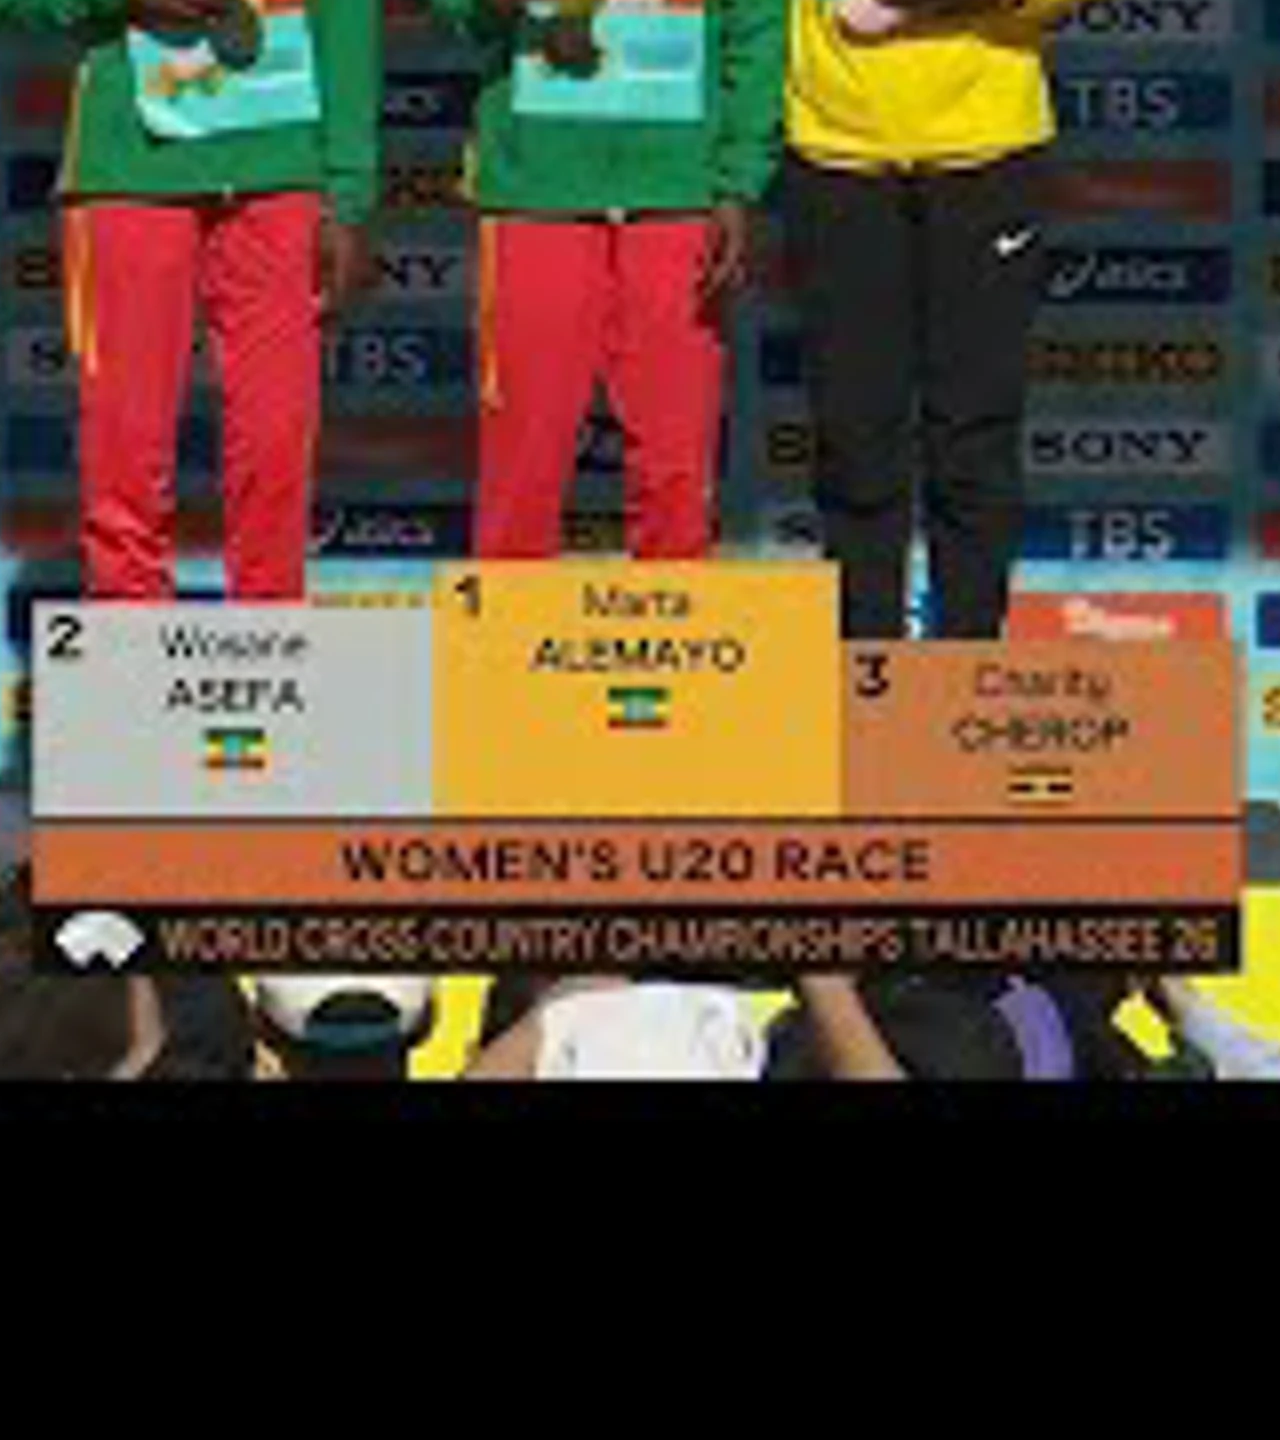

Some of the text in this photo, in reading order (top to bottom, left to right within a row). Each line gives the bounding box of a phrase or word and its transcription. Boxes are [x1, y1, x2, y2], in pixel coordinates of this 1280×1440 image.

[1066, 78, 1184, 128] TBS
[1028, 429, 1207, 463] SONY
[1065, 510, 1177, 557] TBS
